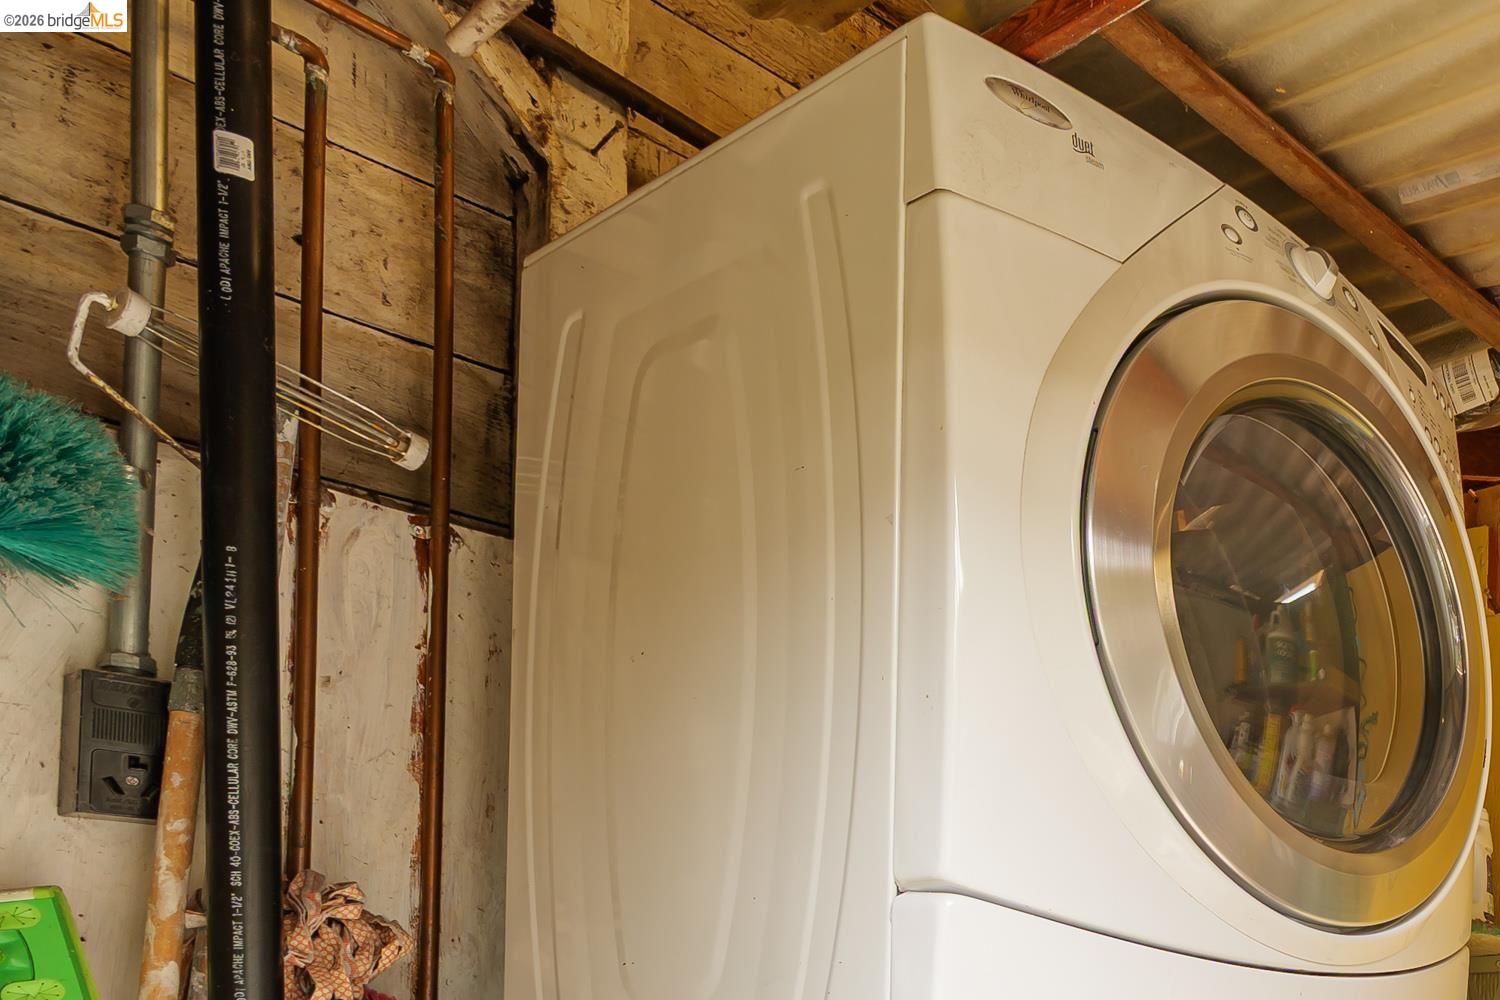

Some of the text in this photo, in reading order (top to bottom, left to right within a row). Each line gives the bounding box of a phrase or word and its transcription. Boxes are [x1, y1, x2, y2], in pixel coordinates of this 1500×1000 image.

[213, 23, 224, 46] CORE
[1011, 84, 1050, 113] Whirlpool
[1071, 132, 1095, 155] duet
[217, 207, 229, 239] IMPACT
[218, 241, 230, 275] APACHE
[227, 738, 239, 760] CORE
[230, 871, 242, 887] SCH
[231, 920, 244, 950] IMPACT
[231, 953, 244, 985] APACHE
